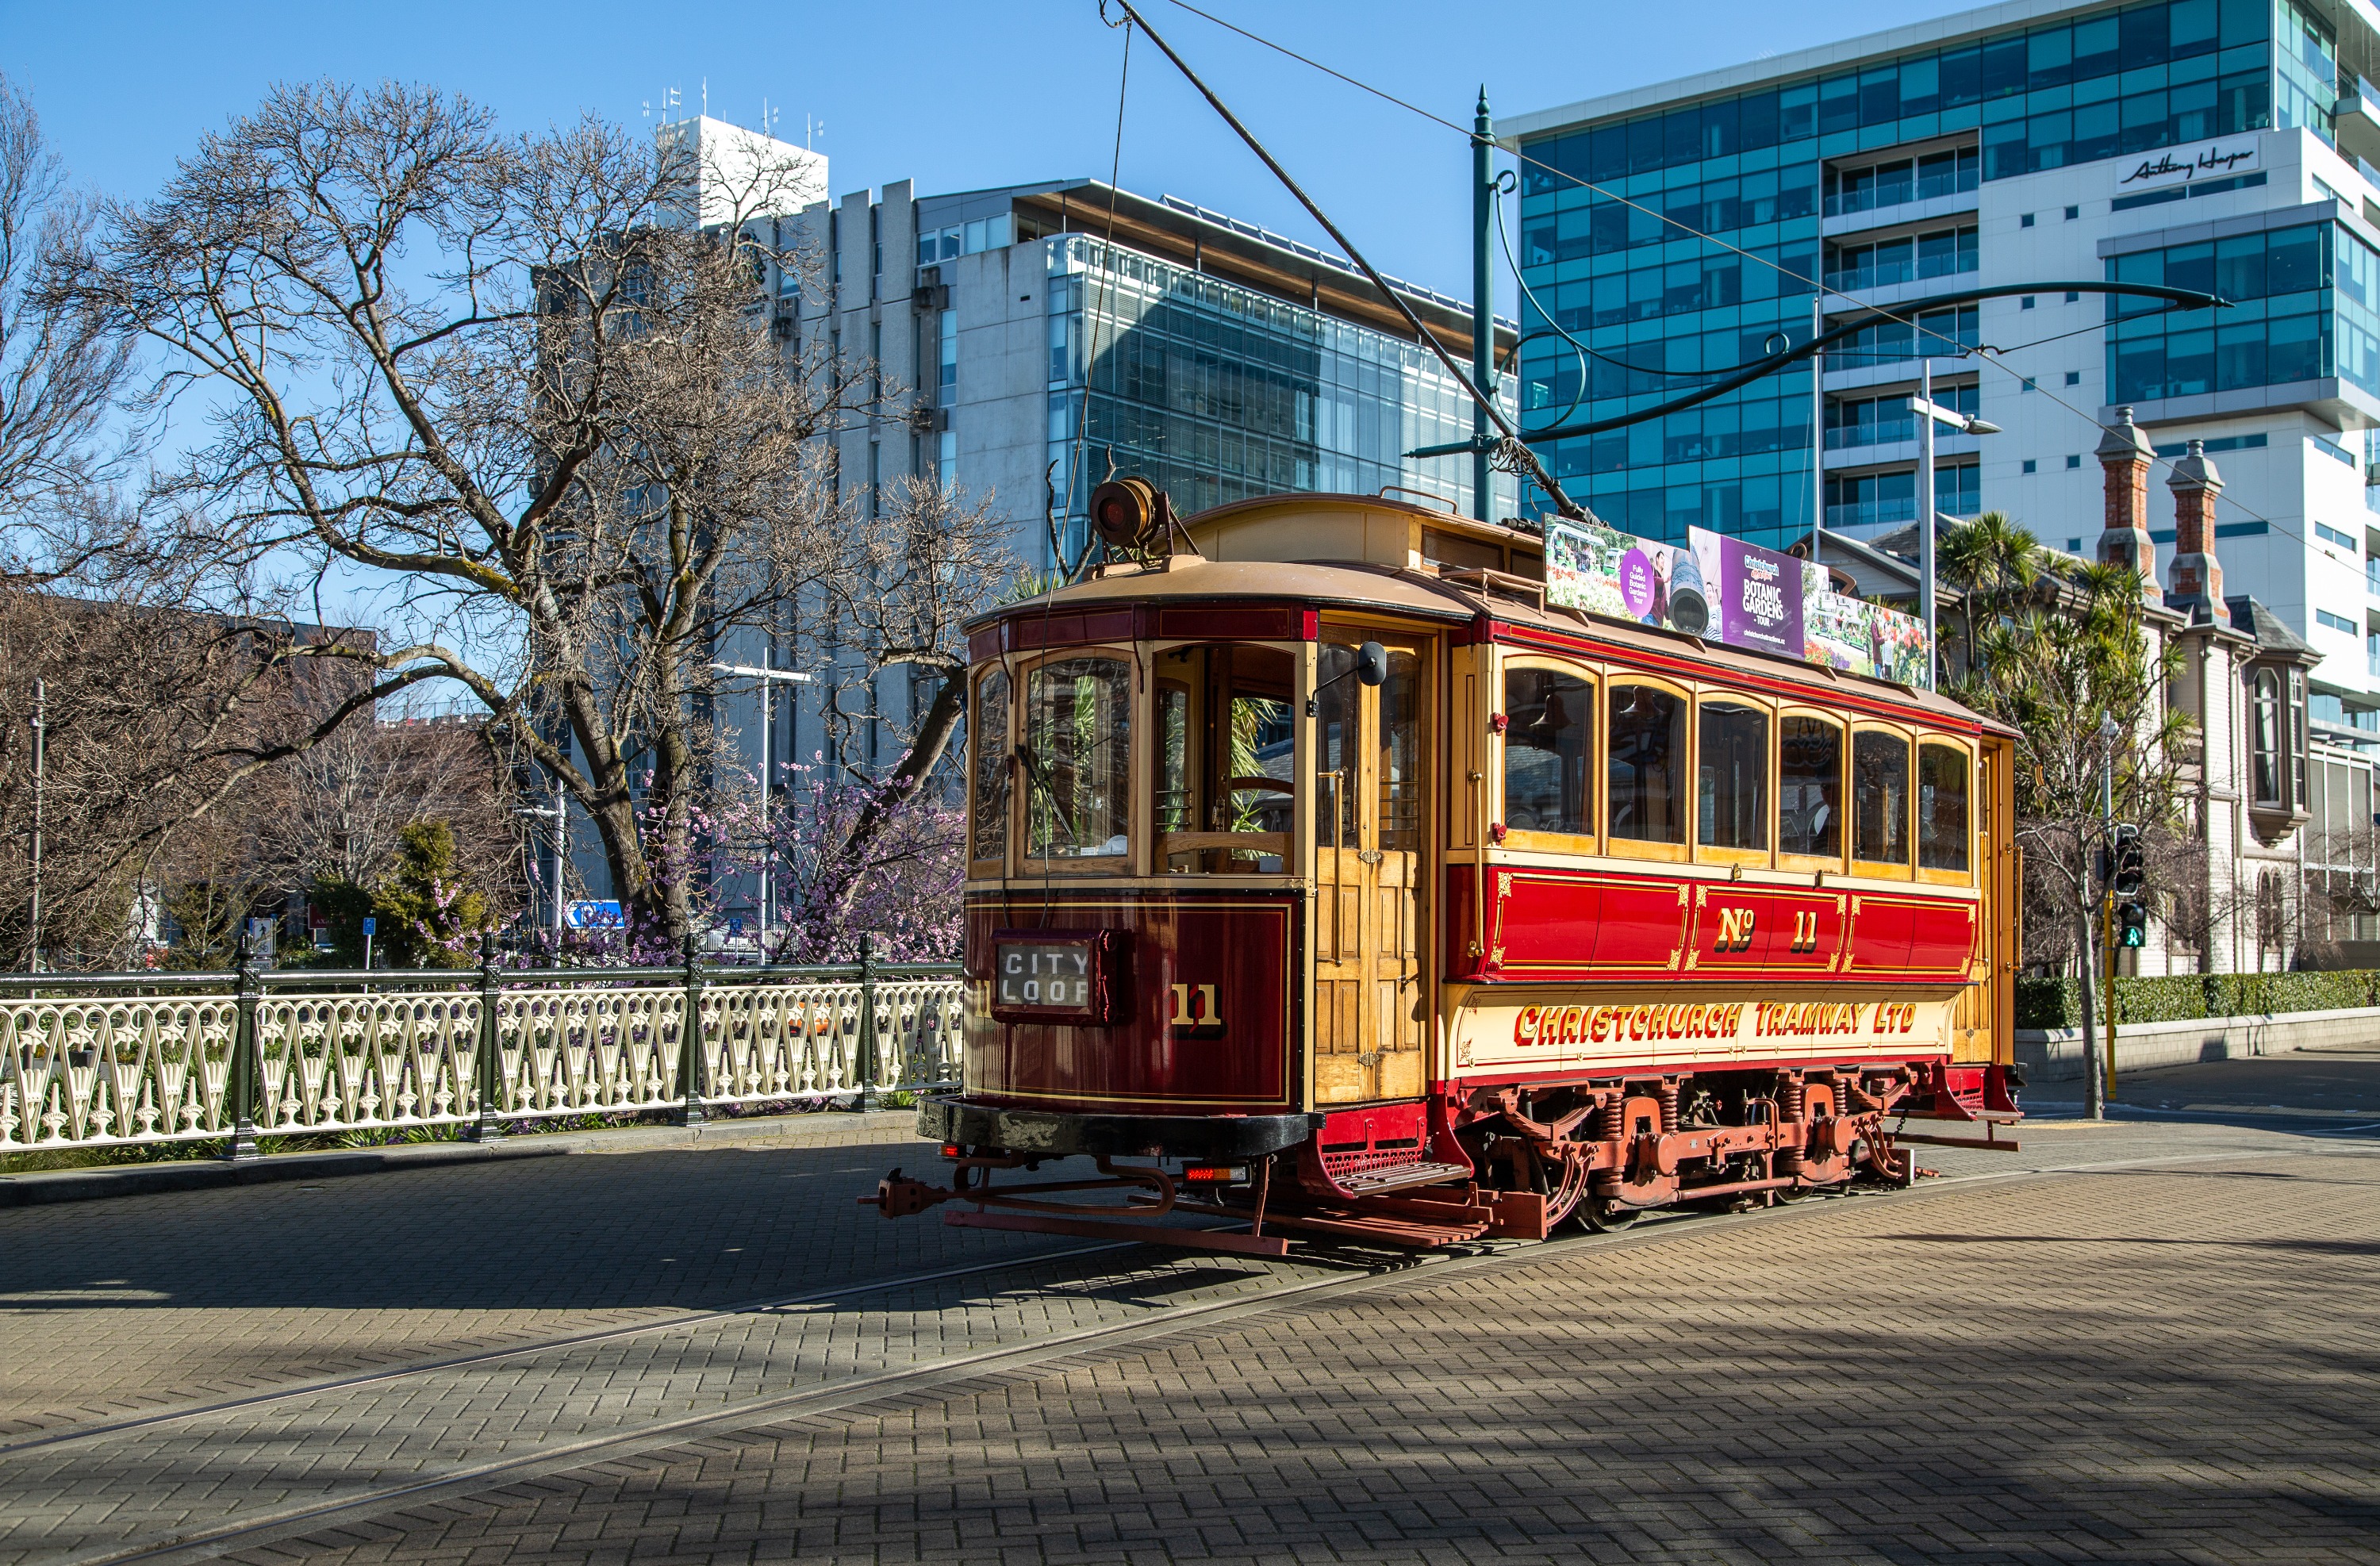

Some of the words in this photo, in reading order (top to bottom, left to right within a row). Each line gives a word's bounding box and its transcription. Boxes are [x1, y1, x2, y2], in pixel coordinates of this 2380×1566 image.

[2120, 153, 2194, 183] Anthony
[1630, 571, 1646, 582] Guided
[1633, 564, 1643, 575] Fully
[1744, 555, 1779, 577] Christchurch
[1629, 579, 1646, 590] Botanic
[1629, 586, 1648, 598] Gardens
[1744, 578, 1782, 605] BOTANIC
[1633, 595, 1643, 605] Tour
[1742, 595, 1783, 620] GARDENS
[1793, 911, 1818, 950] 11
[1005, 954, 1088, 975] CITY
[1169, 984, 1223, 1026] 11
[1514, 1002, 1744, 1046] CHRISTCHURCH
[1756, 999, 1870, 1036] TRAMWAY
[1873, 998, 1916, 1034] LTD
